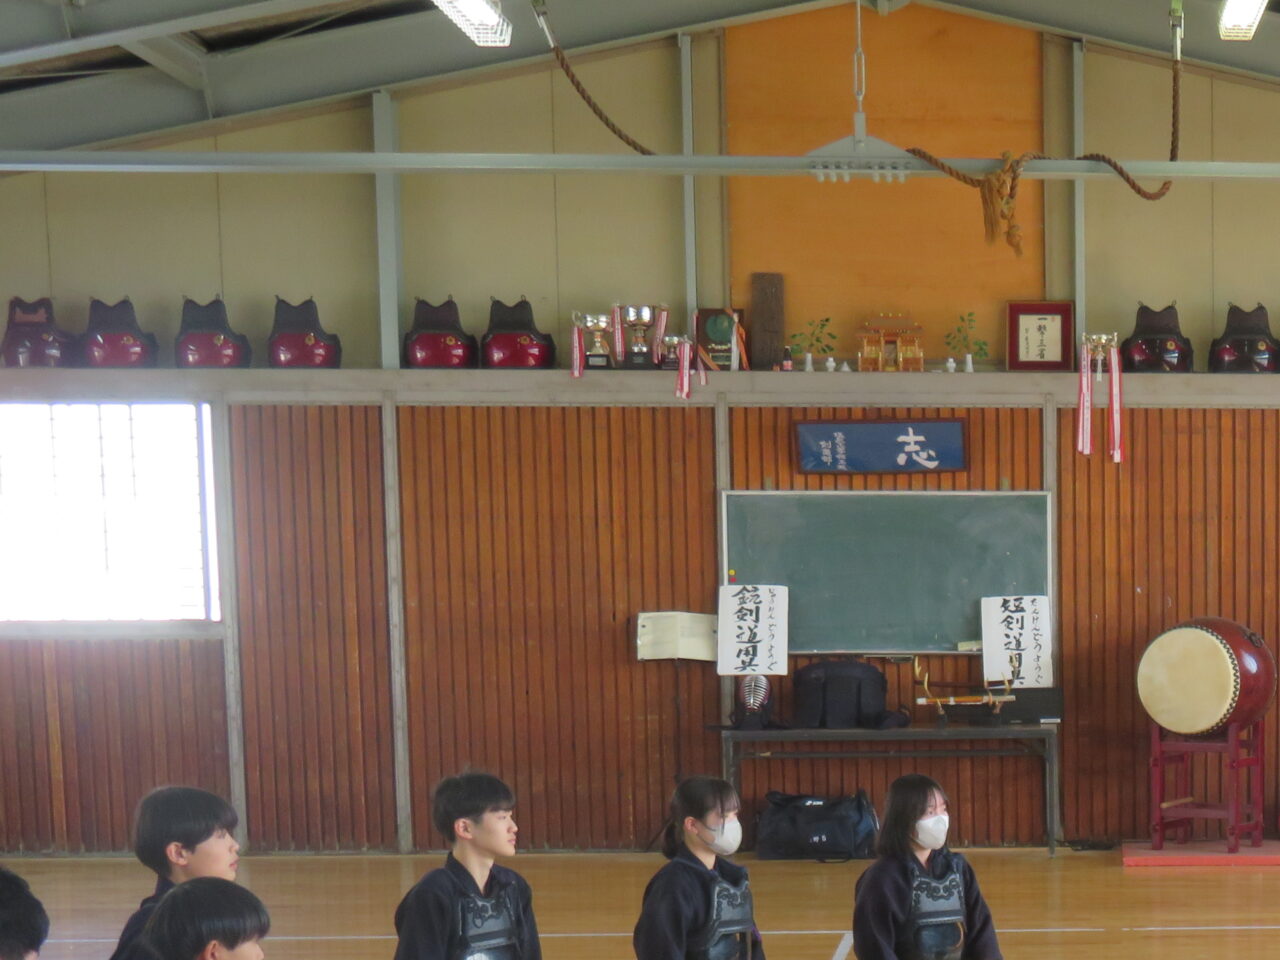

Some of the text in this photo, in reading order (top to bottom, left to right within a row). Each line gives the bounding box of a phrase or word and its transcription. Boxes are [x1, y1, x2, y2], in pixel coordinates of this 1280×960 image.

[896, 427, 940, 469] 志
[731, 586, 764, 672] 銃剣道用具
